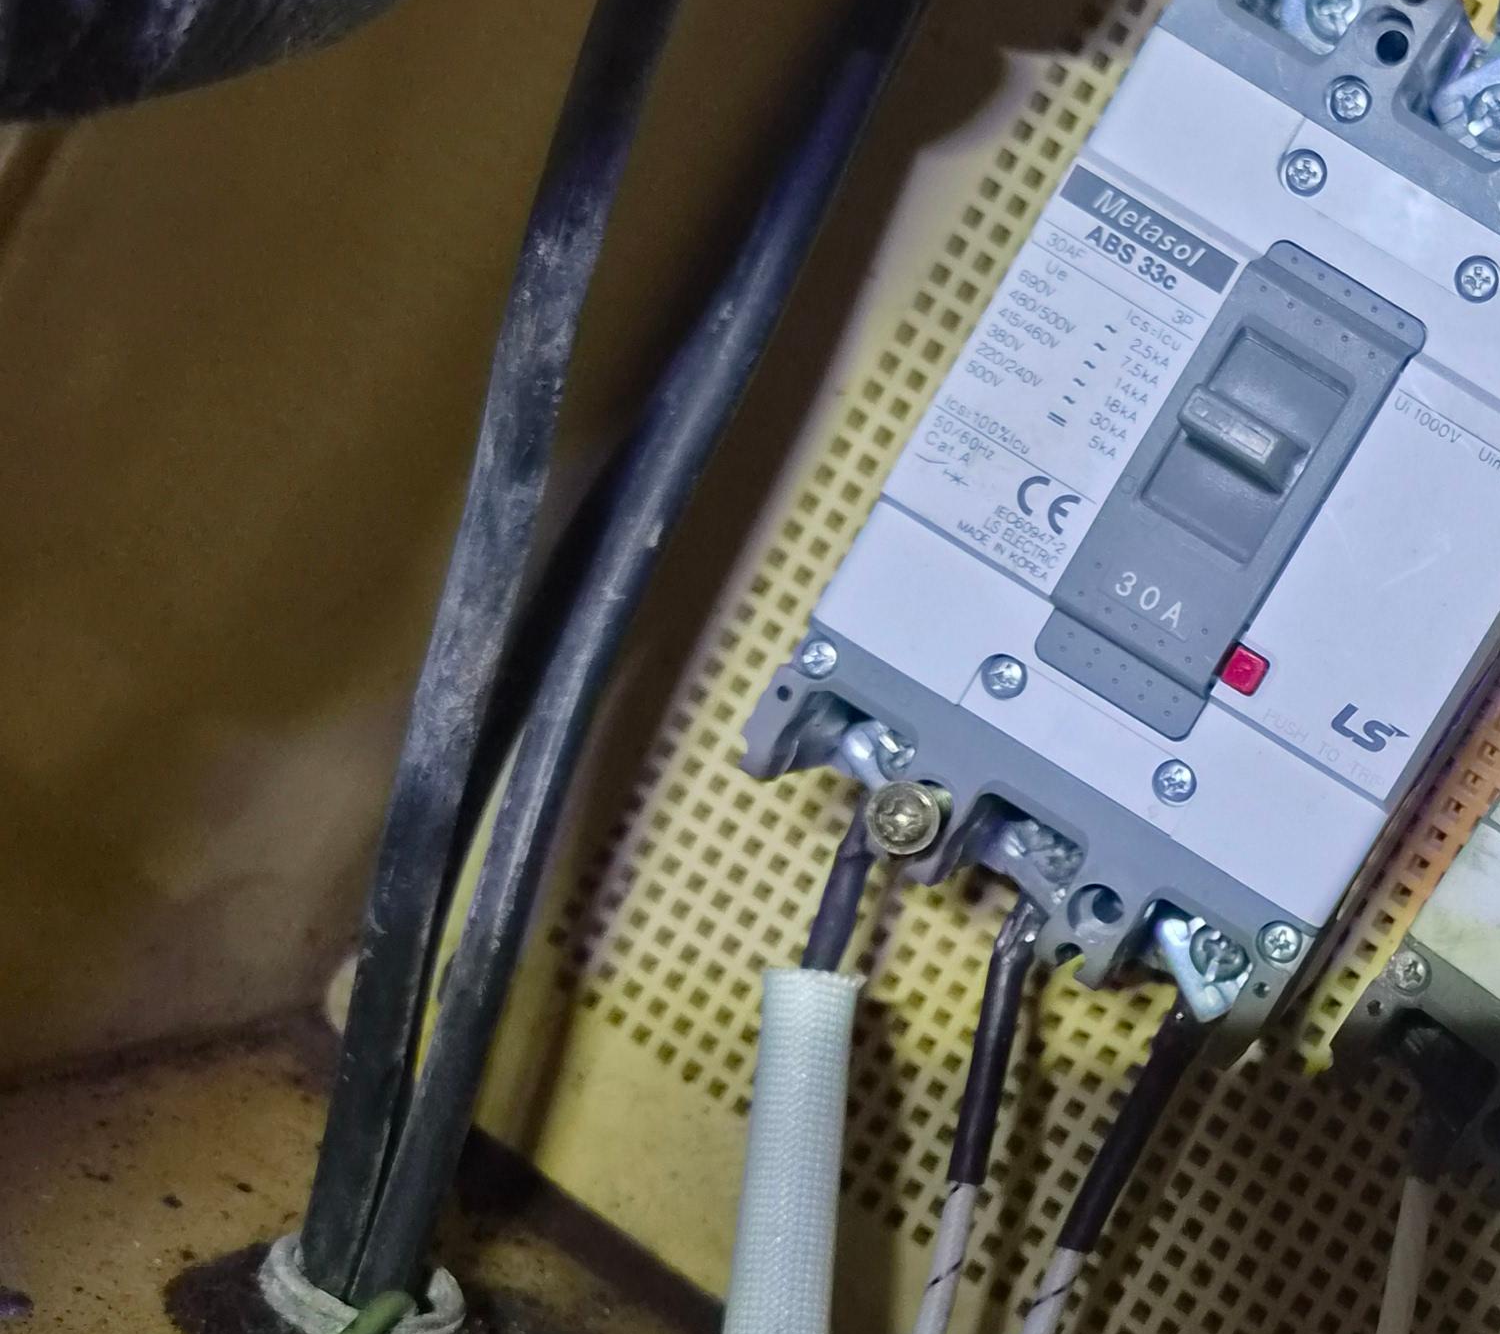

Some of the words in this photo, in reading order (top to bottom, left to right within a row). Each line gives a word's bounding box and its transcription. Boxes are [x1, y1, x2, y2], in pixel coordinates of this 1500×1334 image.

[1092, 189, 1207, 267] Metasol
[1018, 269, 1056, 297] 690V
[1046, 260, 1068, 281] Ue
[1046, 232, 1087, 260] 30AF
[1171, 309, 1194, 326] 3P
[1085, 225, 1137, 265] ABS
[1137, 256, 1178, 291] 33c
[1009, 289, 1077, 334] 480/500V
[987, 324, 1024, 352] 380V
[1105, 396, 1138, 423] 18kA
[998, 307, 1061, 349] 415/460V
[1115, 377, 1148, 405] 14kA
[966, 359, 1004, 388] 500V
[1088, 435, 1116, 459] 5kA
[975, 342, 1044, 388] 220/240V
[1089, 411, 1127, 441] 30kA
[1394, 396, 1410, 413] Ui
[1413, 407, 1462, 444] 1000V
[933, 415, 995, 460] 50/60Hz
[993, 505, 1067, 555] IEC60947-2
[1017, 475, 1082, 535] CE
[957, 520, 989, 547] MADE
[993, 542, 1008, 556] IN
[1008, 551, 1048, 582] KOREA
[984, 516, 1001, 535] LS
[1001, 527, 1061, 568] ELECTRIC
[1114, 571, 1183, 629] 30A
[1330, 703, 1410, 752] LS
